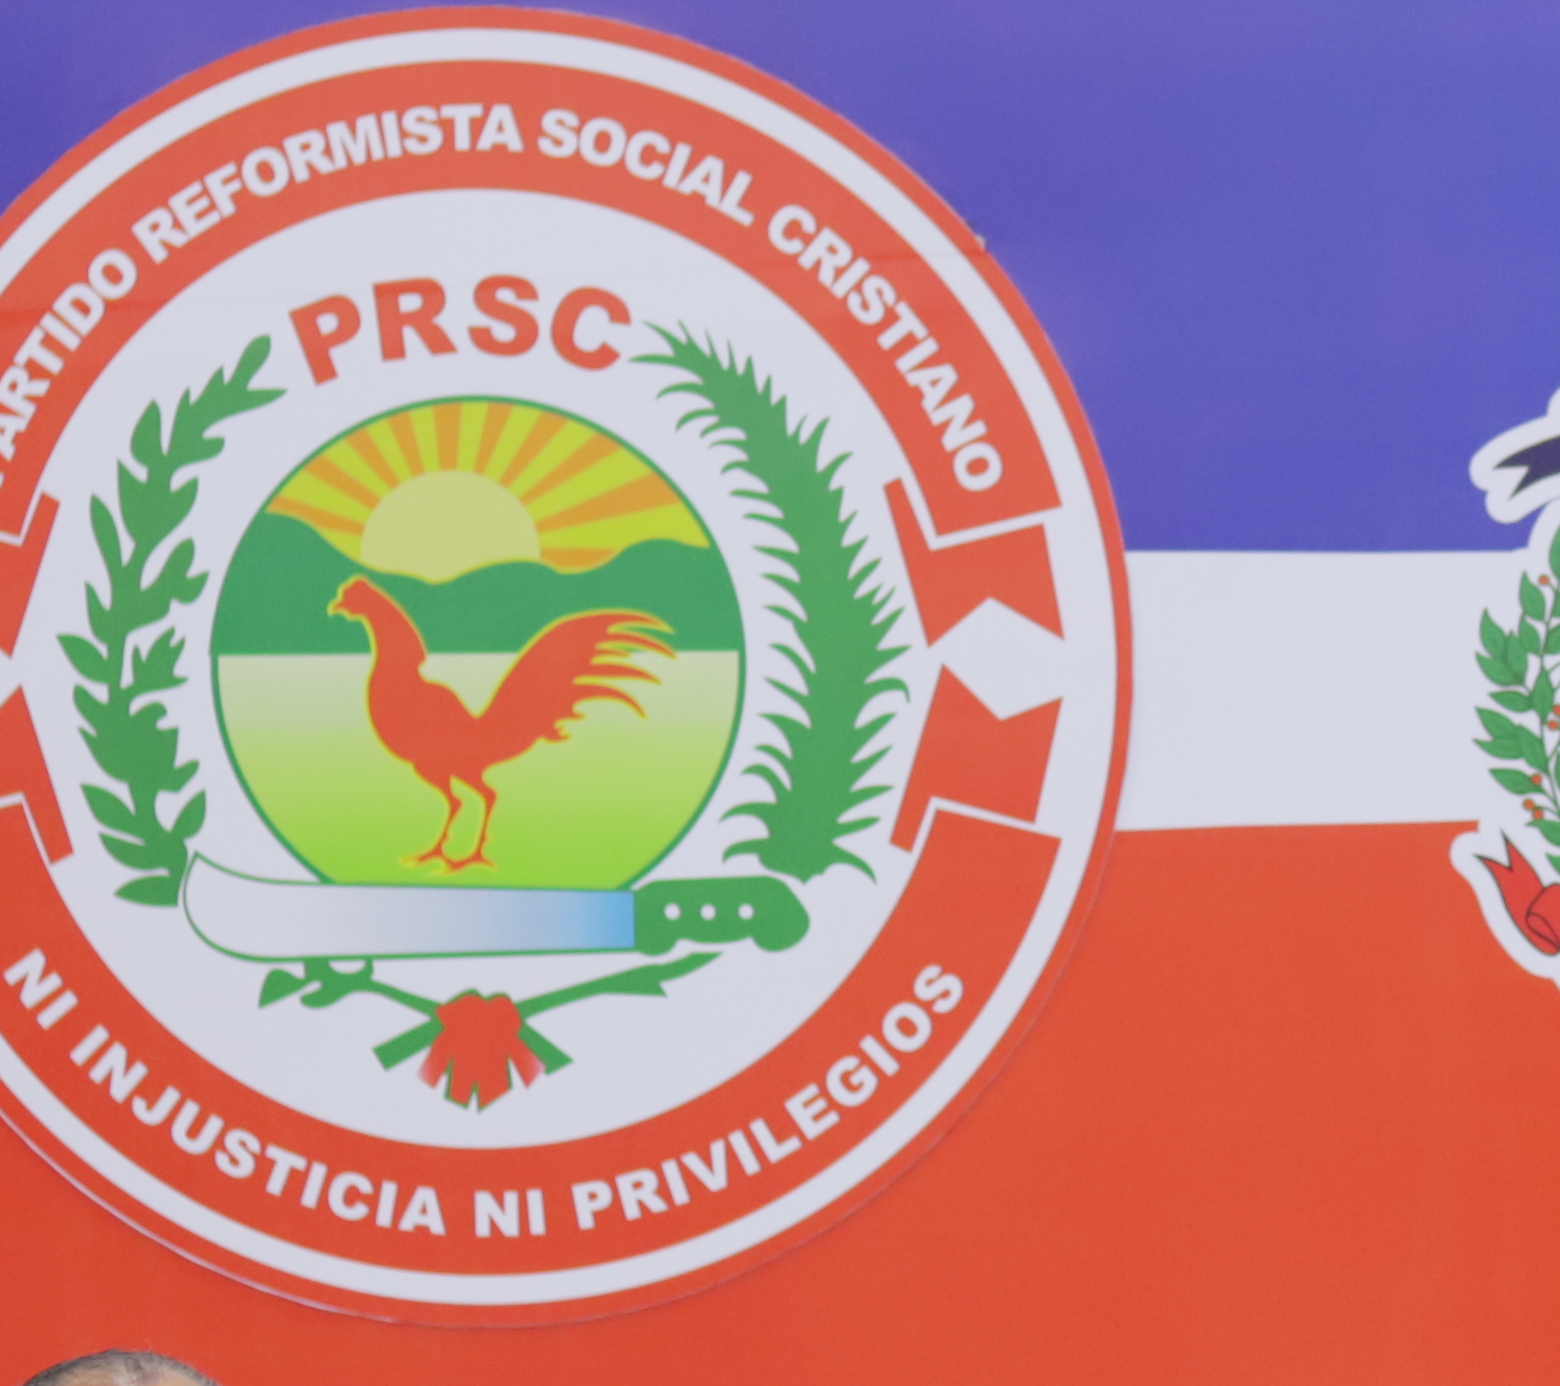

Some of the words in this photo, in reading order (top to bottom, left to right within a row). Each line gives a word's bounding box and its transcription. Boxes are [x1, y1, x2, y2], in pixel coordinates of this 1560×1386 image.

[132, 105, 523, 261] REFORMISTA
[538, 109, 755, 227] SOCIAL
[767, 204, 1004, 496] CRISTIANO
[290, 272, 633, 385] PRSC
[1, 949, 79, 1029] NI
[70, 1022, 446, 1236] INJUSTICIA
[475, 1190, 547, 1238] NI
[571, 963, 966, 1232] PRIVILEGIOS
